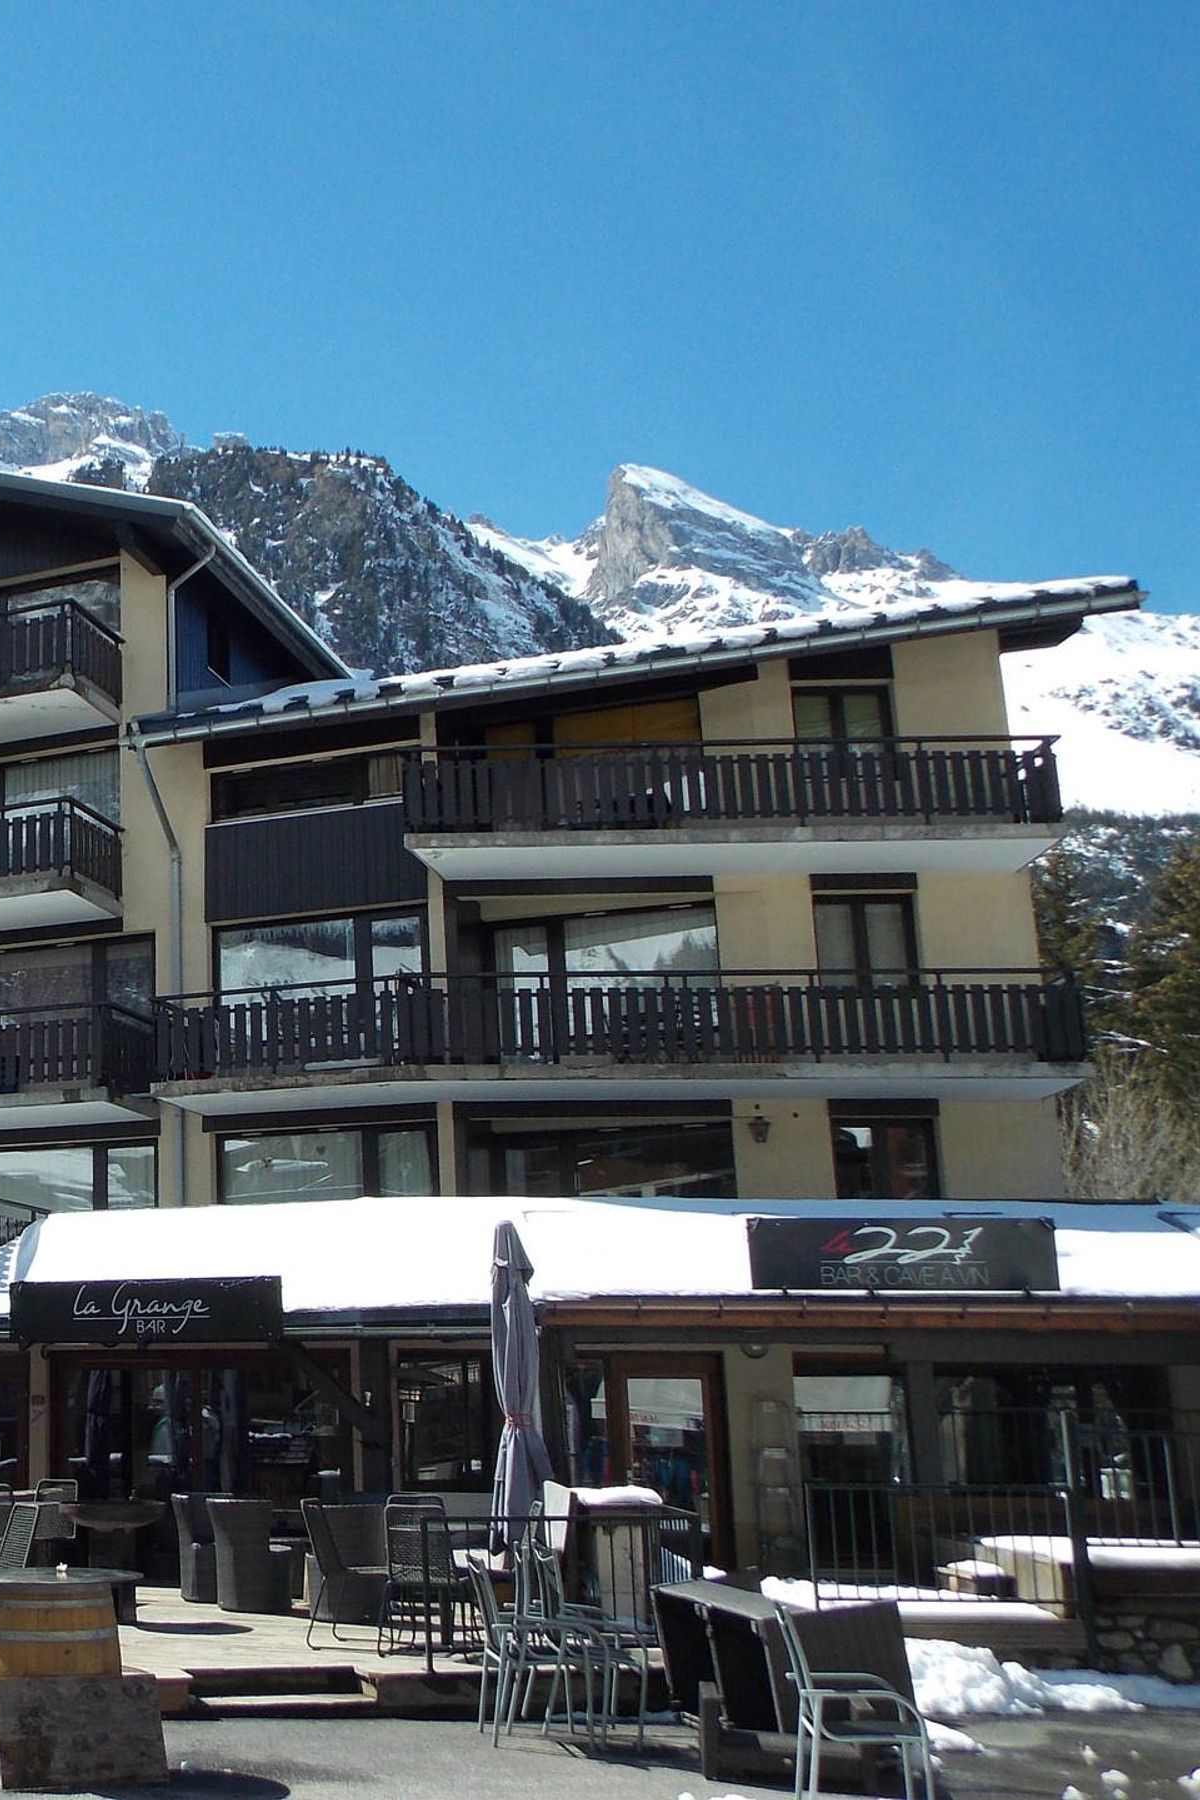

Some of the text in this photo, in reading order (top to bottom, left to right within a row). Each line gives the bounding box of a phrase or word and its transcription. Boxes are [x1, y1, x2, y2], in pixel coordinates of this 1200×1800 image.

[820, 1266, 862, 1285] BAR
[867, 1267, 880, 1285] &
[883, 1266, 937, 1286] CAVE
[956, 1267, 990, 1286] VIN
[73, 1281, 210, 1335] La Grange
[136, 1320, 166, 1334] BAR
